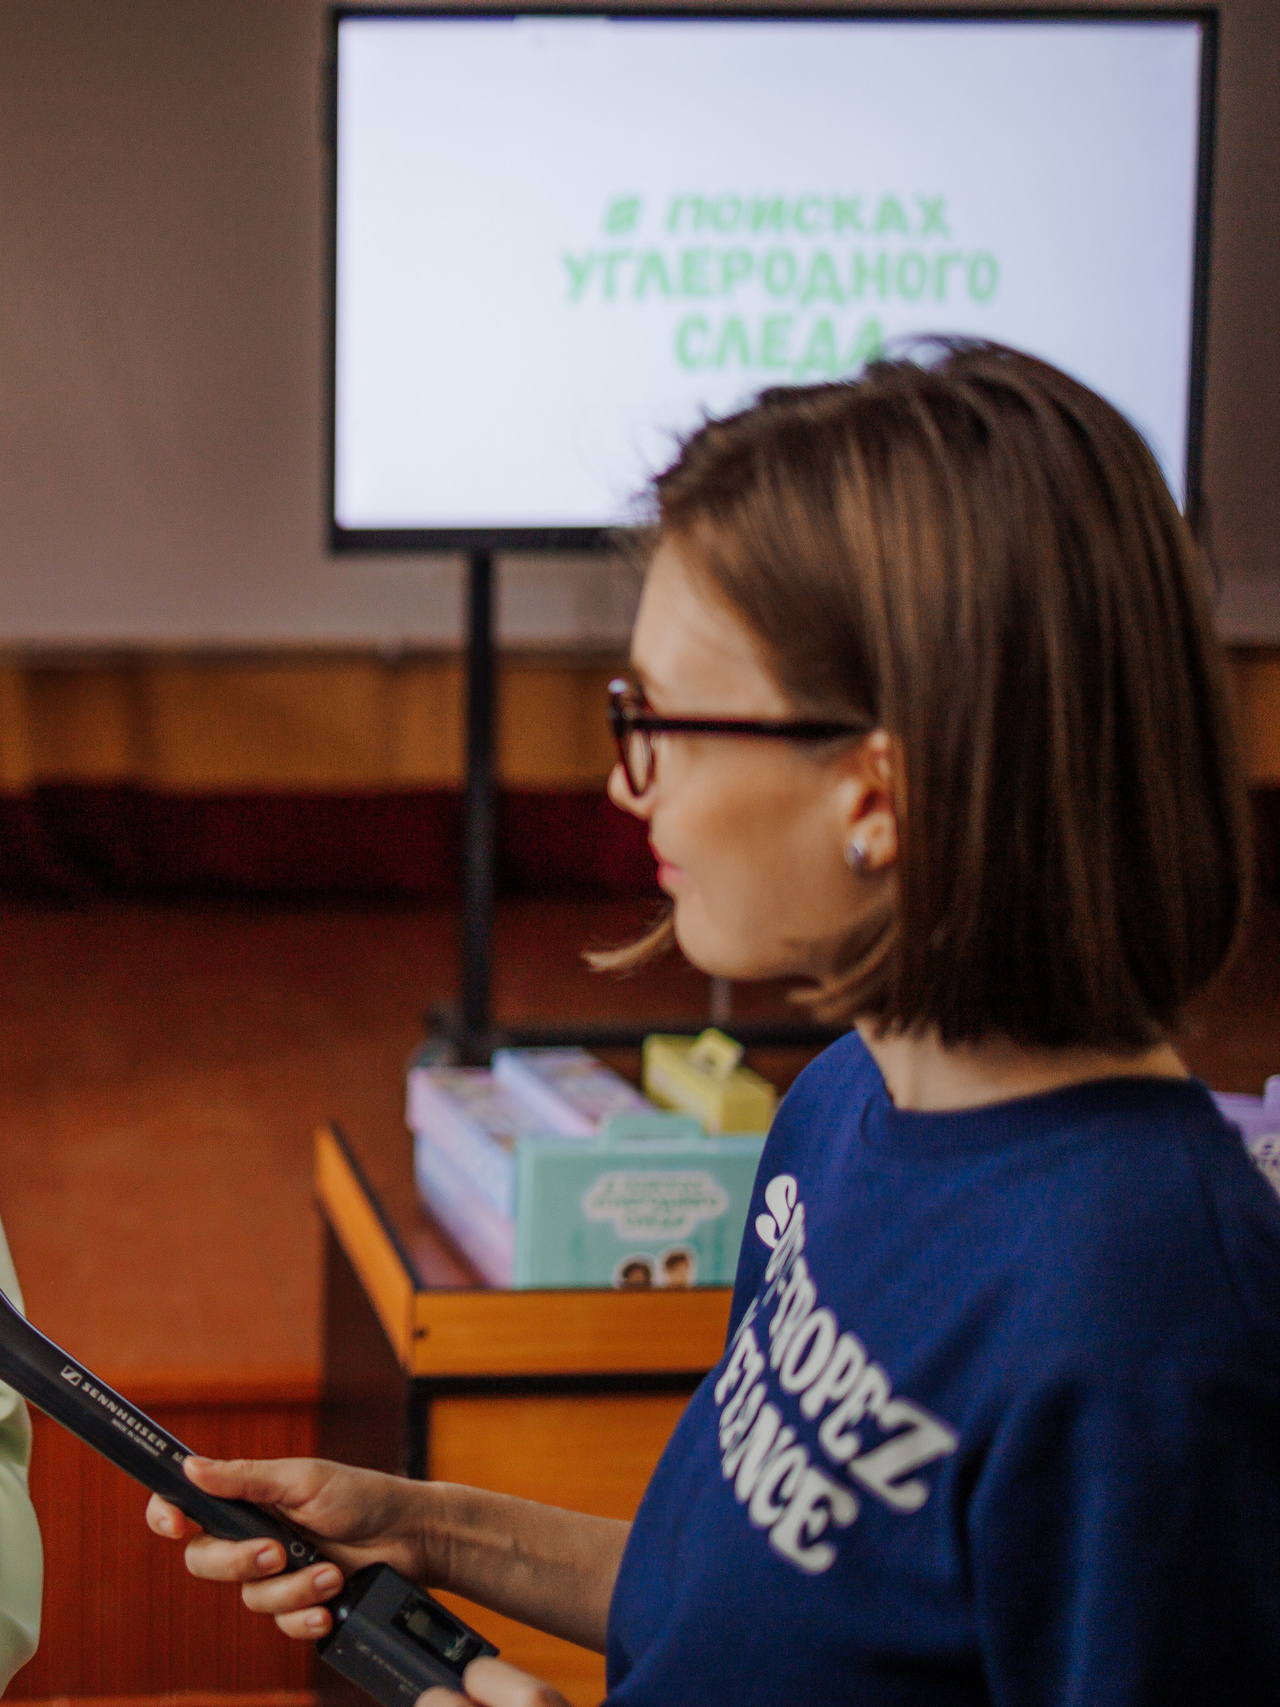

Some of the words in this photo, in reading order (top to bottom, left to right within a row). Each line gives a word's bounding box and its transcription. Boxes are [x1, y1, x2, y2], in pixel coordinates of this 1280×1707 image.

[667, 193, 949, 238] ПОИСКАХ
[563, 248, 999, 306] УГЛЕРОДНОГО
[675, 313, 884, 378] СЛЕДА
[81, 1382, 168, 1451] SENNHEISER
